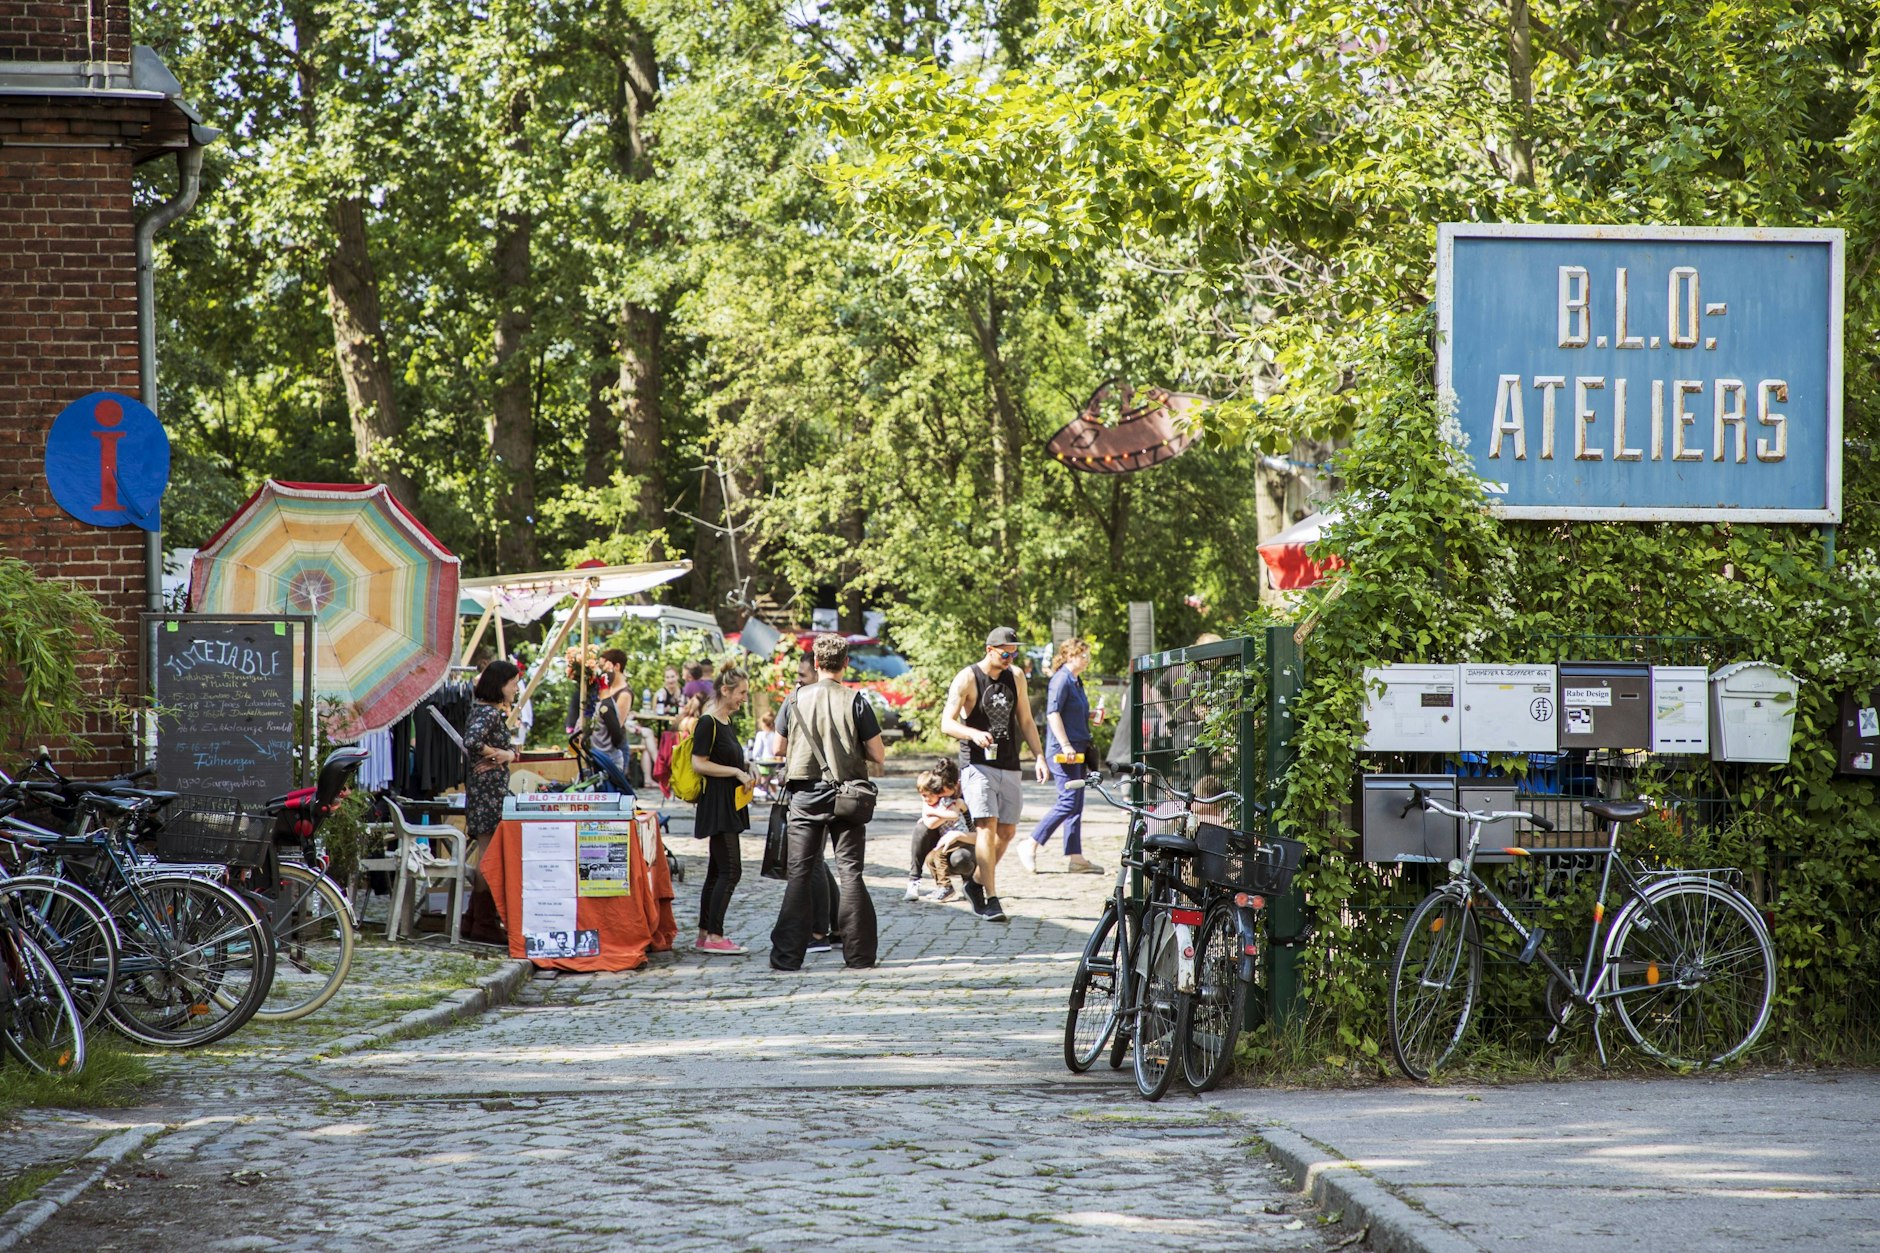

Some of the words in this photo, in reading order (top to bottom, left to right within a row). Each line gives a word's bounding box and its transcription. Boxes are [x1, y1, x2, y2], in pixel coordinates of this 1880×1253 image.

[1488, 374, 1789, 464] ATELIERS
[163, 639, 280, 677] TIMETABLE
[1586, 690, 1609, 698] Design
[1535, 709, 1548, 721] 37
[193, 752, 255, 771] Führungen
[1496, 900, 1531, 941] PEUGEO
